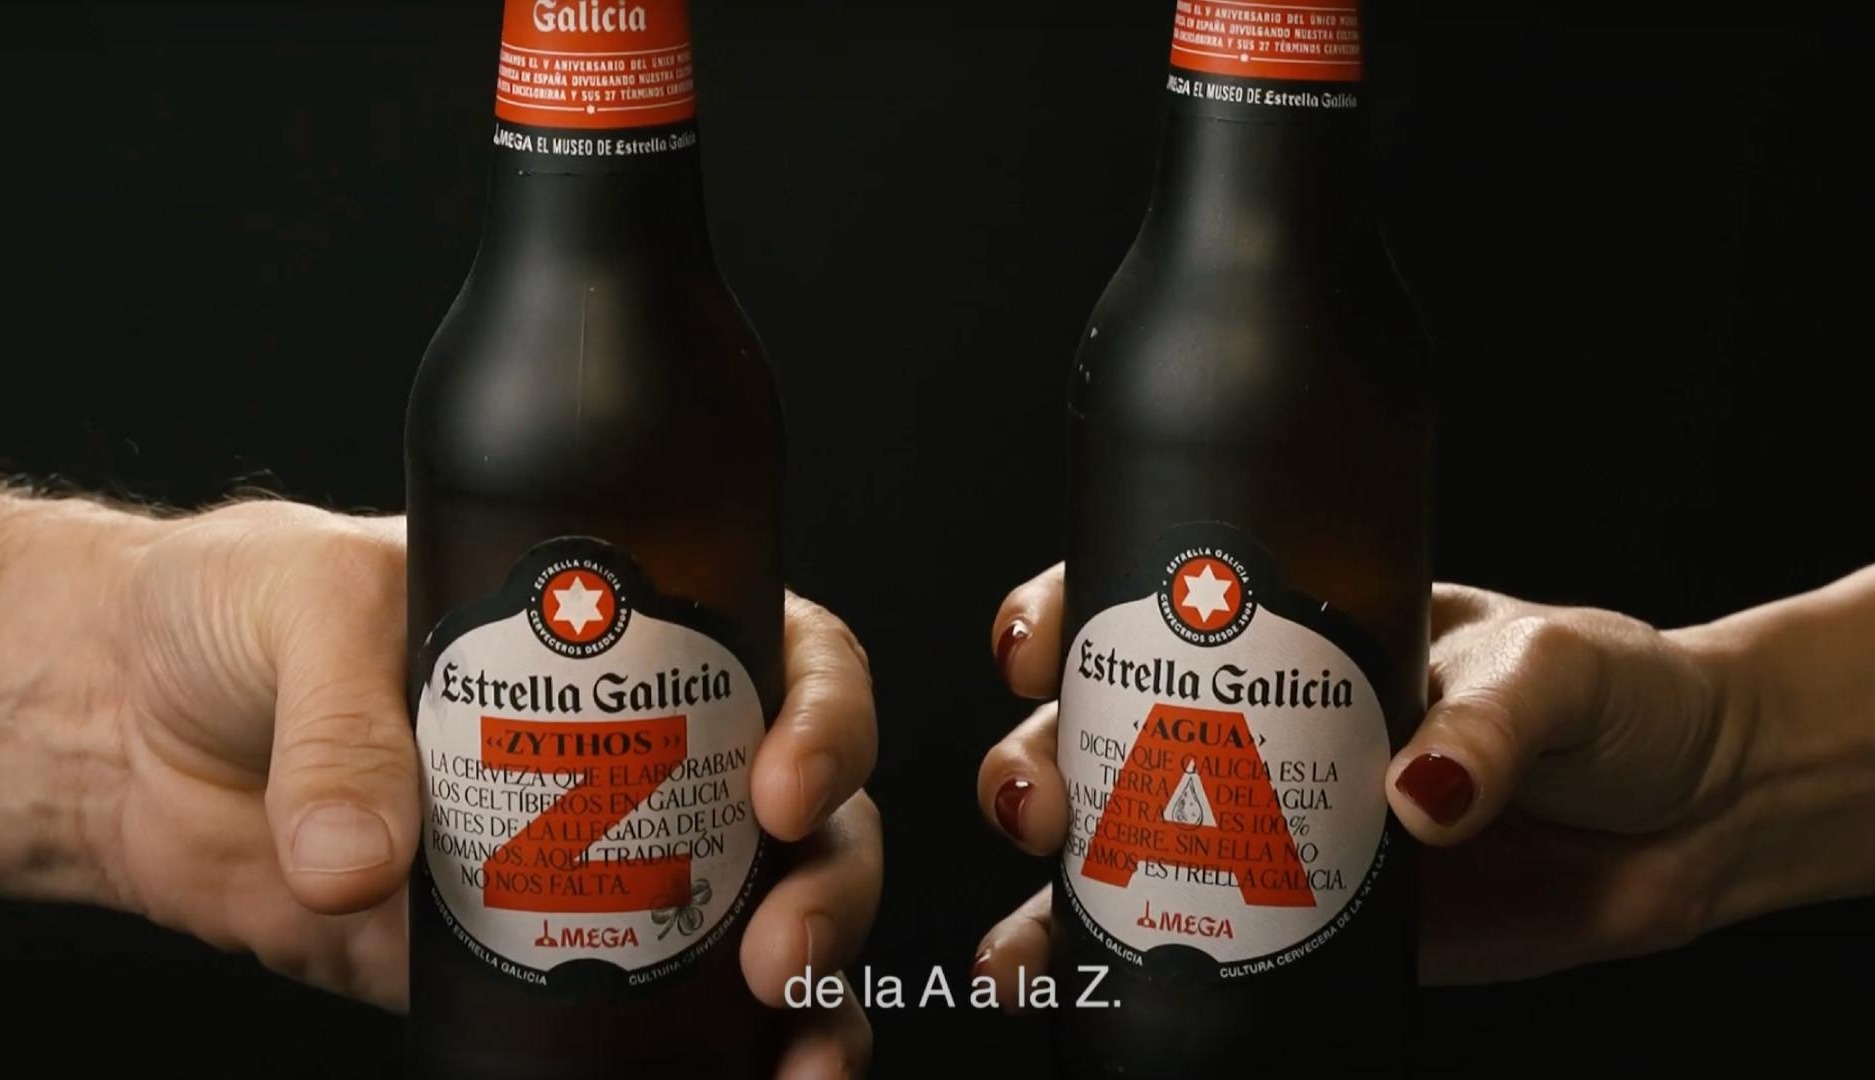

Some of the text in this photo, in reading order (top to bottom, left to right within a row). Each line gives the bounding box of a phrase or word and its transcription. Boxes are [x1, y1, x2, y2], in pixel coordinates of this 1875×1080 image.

[533, 0, 647, 33] Galicia
[1196, 18, 1225, 34] ESPAÑA
[1229, 23, 1291, 39] DIVULGANDO
[1294, 27, 1334, 41] NUESTRA
[1215, 7, 1281, 24] ANIVERSARIO
[1287, 12, 1305, 26] DEL
[554, 59, 625, 72] ANIVERSARIO
[630, 58, 648, 71] DEL
[1237, 38, 1255, 51] SUS
[1274, 39, 1321, 55] TÉRMINOS
[533, 72, 568, 87] ESPAÑA
[571, 75, 636, 88] DIVULGANDO
[582, 90, 600, 102] SUS
[1193, 80, 1204, 98] EL
[1206, 83, 1243, 104] MUSEO
[1246, 86, 1261, 105] DE
[1263, 89, 1319, 108] Estrella
[537, 136, 549, 155] EL
[552, 138, 593, 156] MUSEO
[597, 138, 612, 156] DE
[614, 138, 668, 156] Estrella
[534, 559, 622, 591] ESTRELLA GALICIA
[1166, 547, 1250, 584] ESTRELLA GALICIA
[529, 609, 582, 656] CERVECEROS
[584, 632, 616, 655] DESDE
[1160, 593, 1206, 644] CERVECEROS
[1208, 624, 1240, 644] DESDE
[441, 662, 733, 715] Estrella Galicia
[1078, 639, 1353, 710] Estrella Galicia
[431, 745, 747, 791] LA CERVEZA QUE ELABORABAN
[1080, 730, 1339, 783] DICEN QUE GALICIA ES LA
[431, 775, 729, 815] LOS CELTÍBEROS EN GALICIA
[1100, 763, 1333, 811] TIERRA DEL AGUA.
[431, 801, 746, 842] ANTES DE LA LLEGADA DE LOS
[1083, 784, 1167, 824] NUESTRA
[1218, 811, 1245, 834] ES
[1253, 814, 1310, 837] 100%
[433, 830, 528, 867] ROMANOS.
[597, 829, 724, 868] TRADICIÓN
[1176, 833, 1211, 858] SIN
[1218, 838, 1274, 863] ELLA
[1283, 841, 1319, 865] NO
[461, 863, 631, 898] NO NOS FALTA.
[1145, 857, 1256, 889] ESTRELLA
[1260, 867, 1347, 892] GALICIA.
[1071, 898, 1143, 967] ESTRELLA GALICIA
[1219, 960, 1275, 979] CULTURA
[1276, 926, 1338, 967] CERVECERA
[1336, 909, 1351, 930] DE
[453, 923, 498, 968] ESTRELLA
[501, 961, 548, 986] GALICIA
[628, 959, 682, 986] CULTURA
